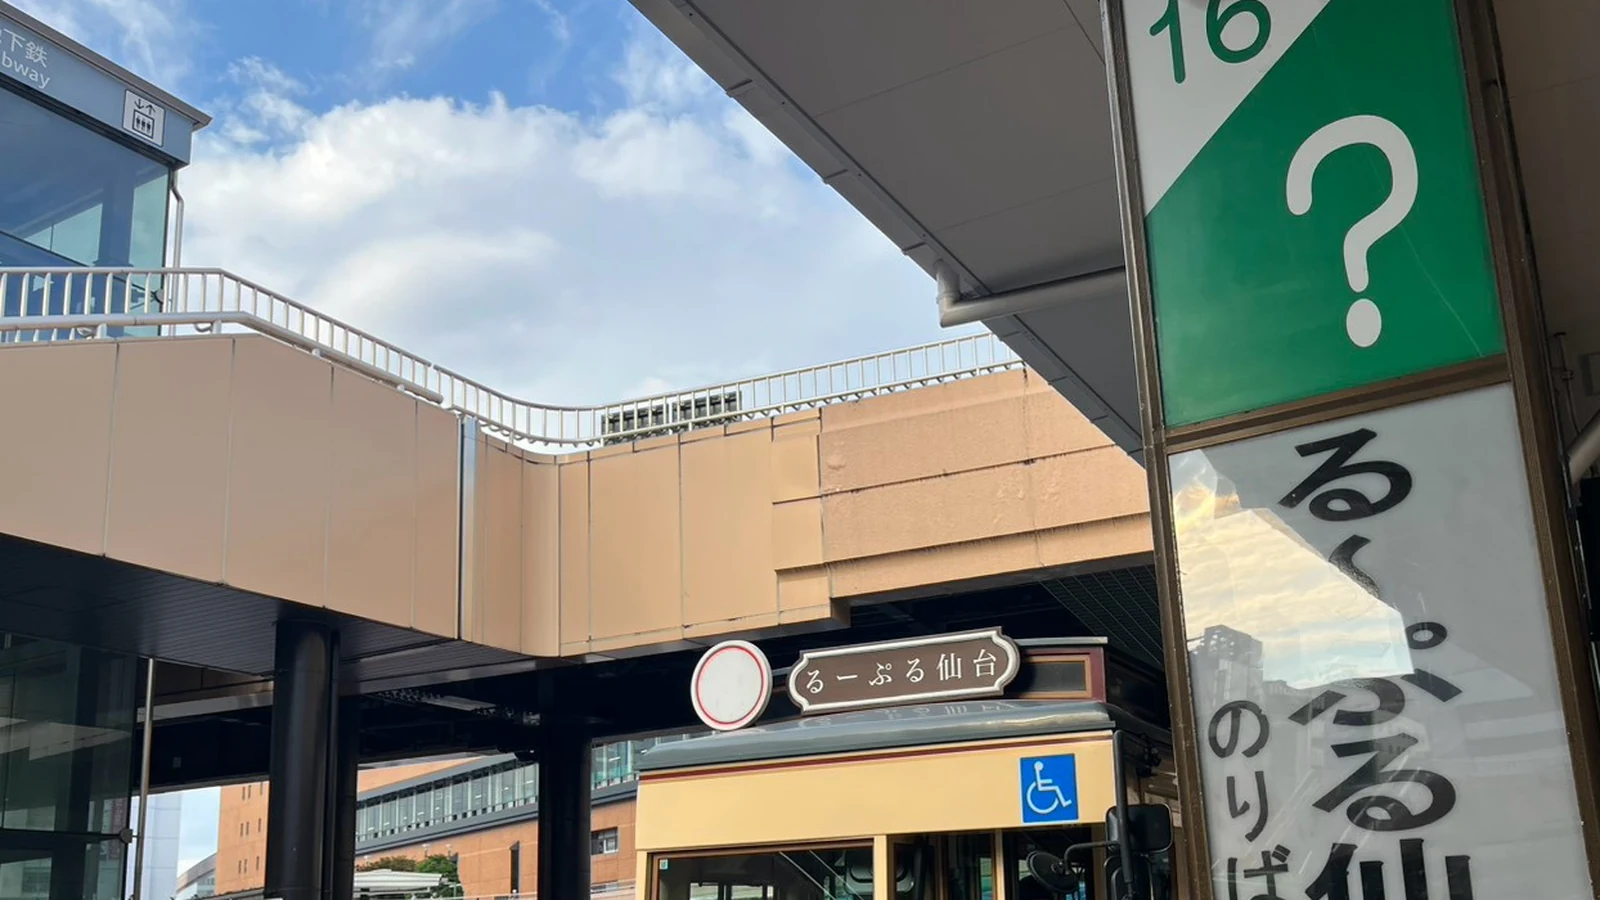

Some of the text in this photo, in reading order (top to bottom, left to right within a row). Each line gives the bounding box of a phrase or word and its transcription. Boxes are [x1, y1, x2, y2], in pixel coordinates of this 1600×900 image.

[0, 28, 47, 68] 下鉄
[1149, 0, 1272, 84] 16
[806, 648, 998, 694] るーぷる仙台
